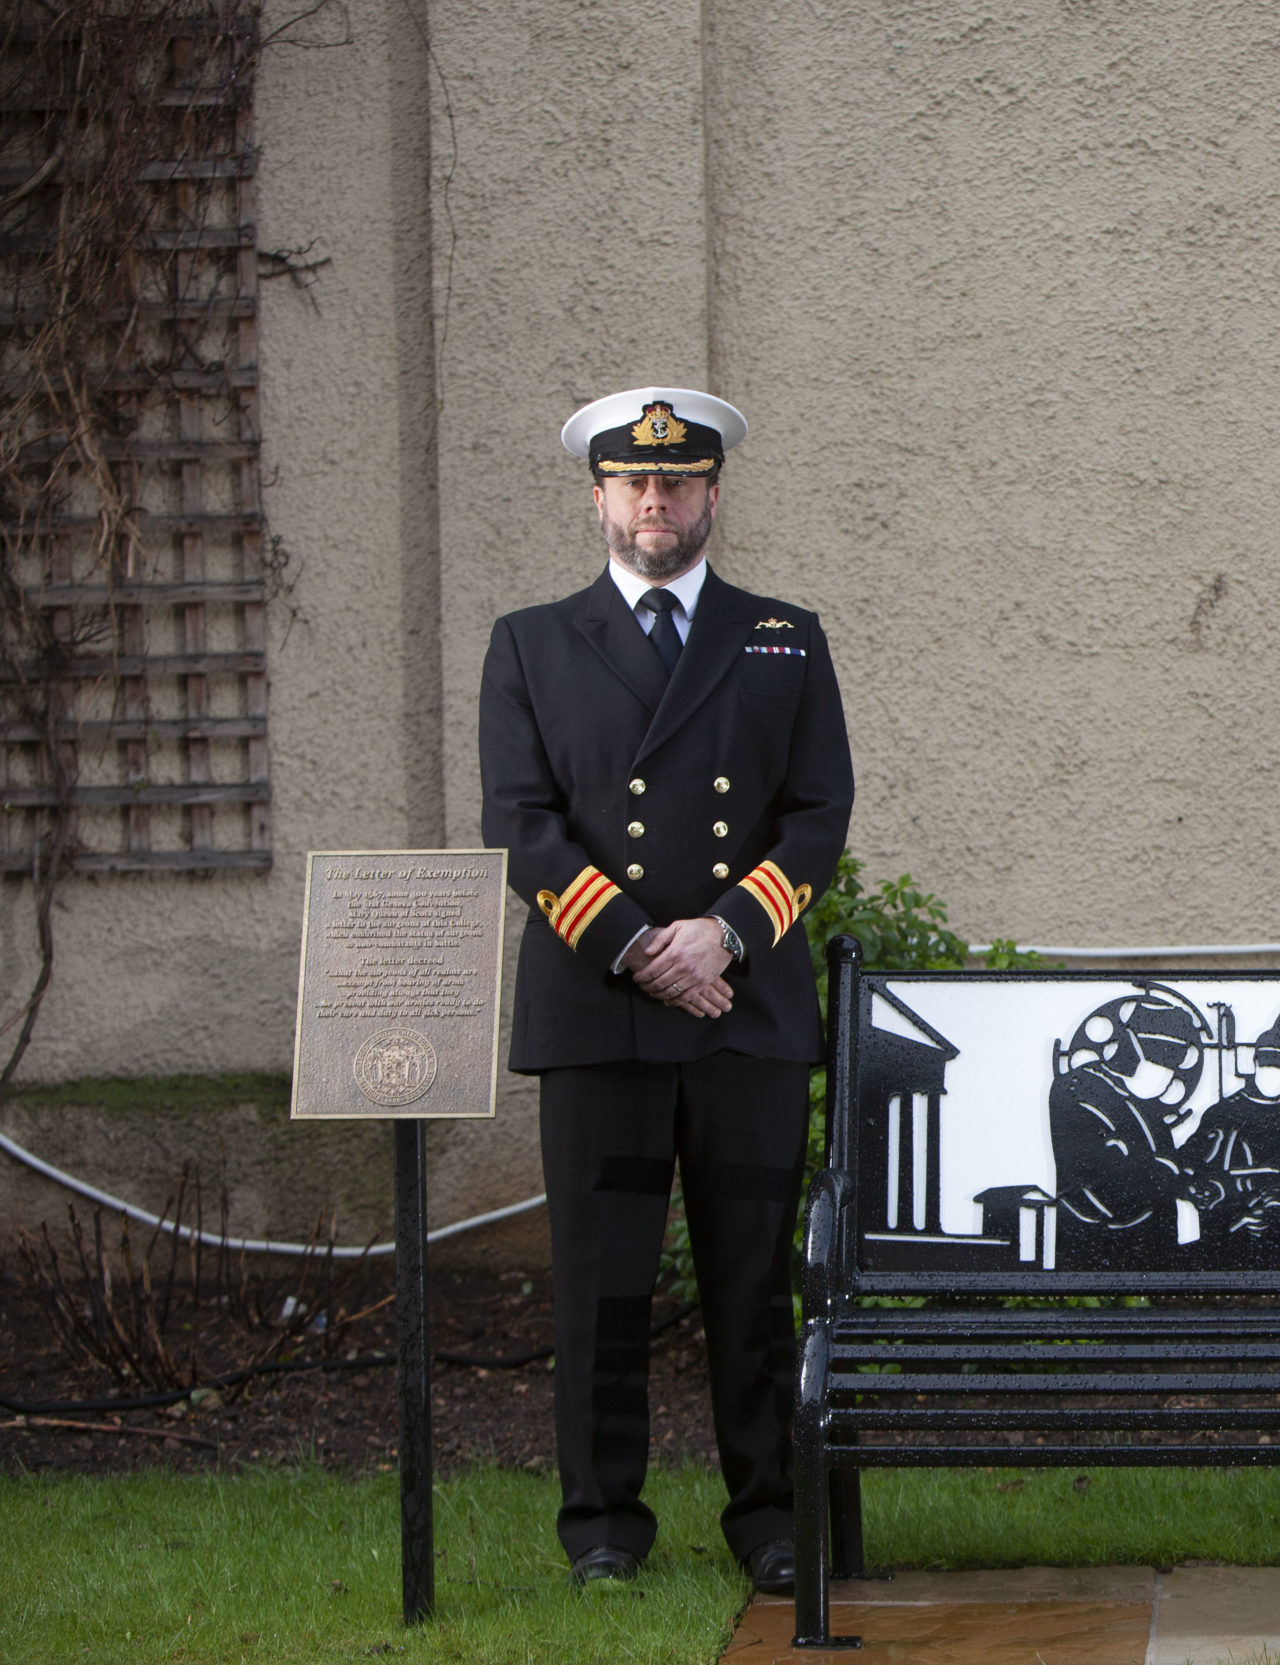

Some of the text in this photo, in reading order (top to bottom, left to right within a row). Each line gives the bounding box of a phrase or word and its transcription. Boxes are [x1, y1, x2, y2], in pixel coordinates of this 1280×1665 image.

[326, 867, 488, 882] The Letter of Exemption
[345, 891, 362, 900] May
[429, 891, 450, 899] years
[453, 890, 479, 898] before
[349, 911, 369, 919] Mary
[401, 910, 409, 918] of
[434, 910, 461, 918] signed
[360, 958, 377, 966] The
[408, 955, 444, 965] decreed
[354, 969, 368, 977] the
[370, 970, 407, 978] surgeons
[409, 969, 419, 977] of
[419, 968, 431, 976] all
[374, 979, 396, 988] from
[432, 979, 442, 987] of
[390, 990, 420, 998] always
[422, 989, 442, 997] that
[444, 989, 459, 997] they
[368, 999, 386, 1008] with
[436, 999, 461, 1008] ready
[463, 998, 472, 1006] to
[473, 998, 485, 1006] do
[400, 1009, 408, 1017] to
